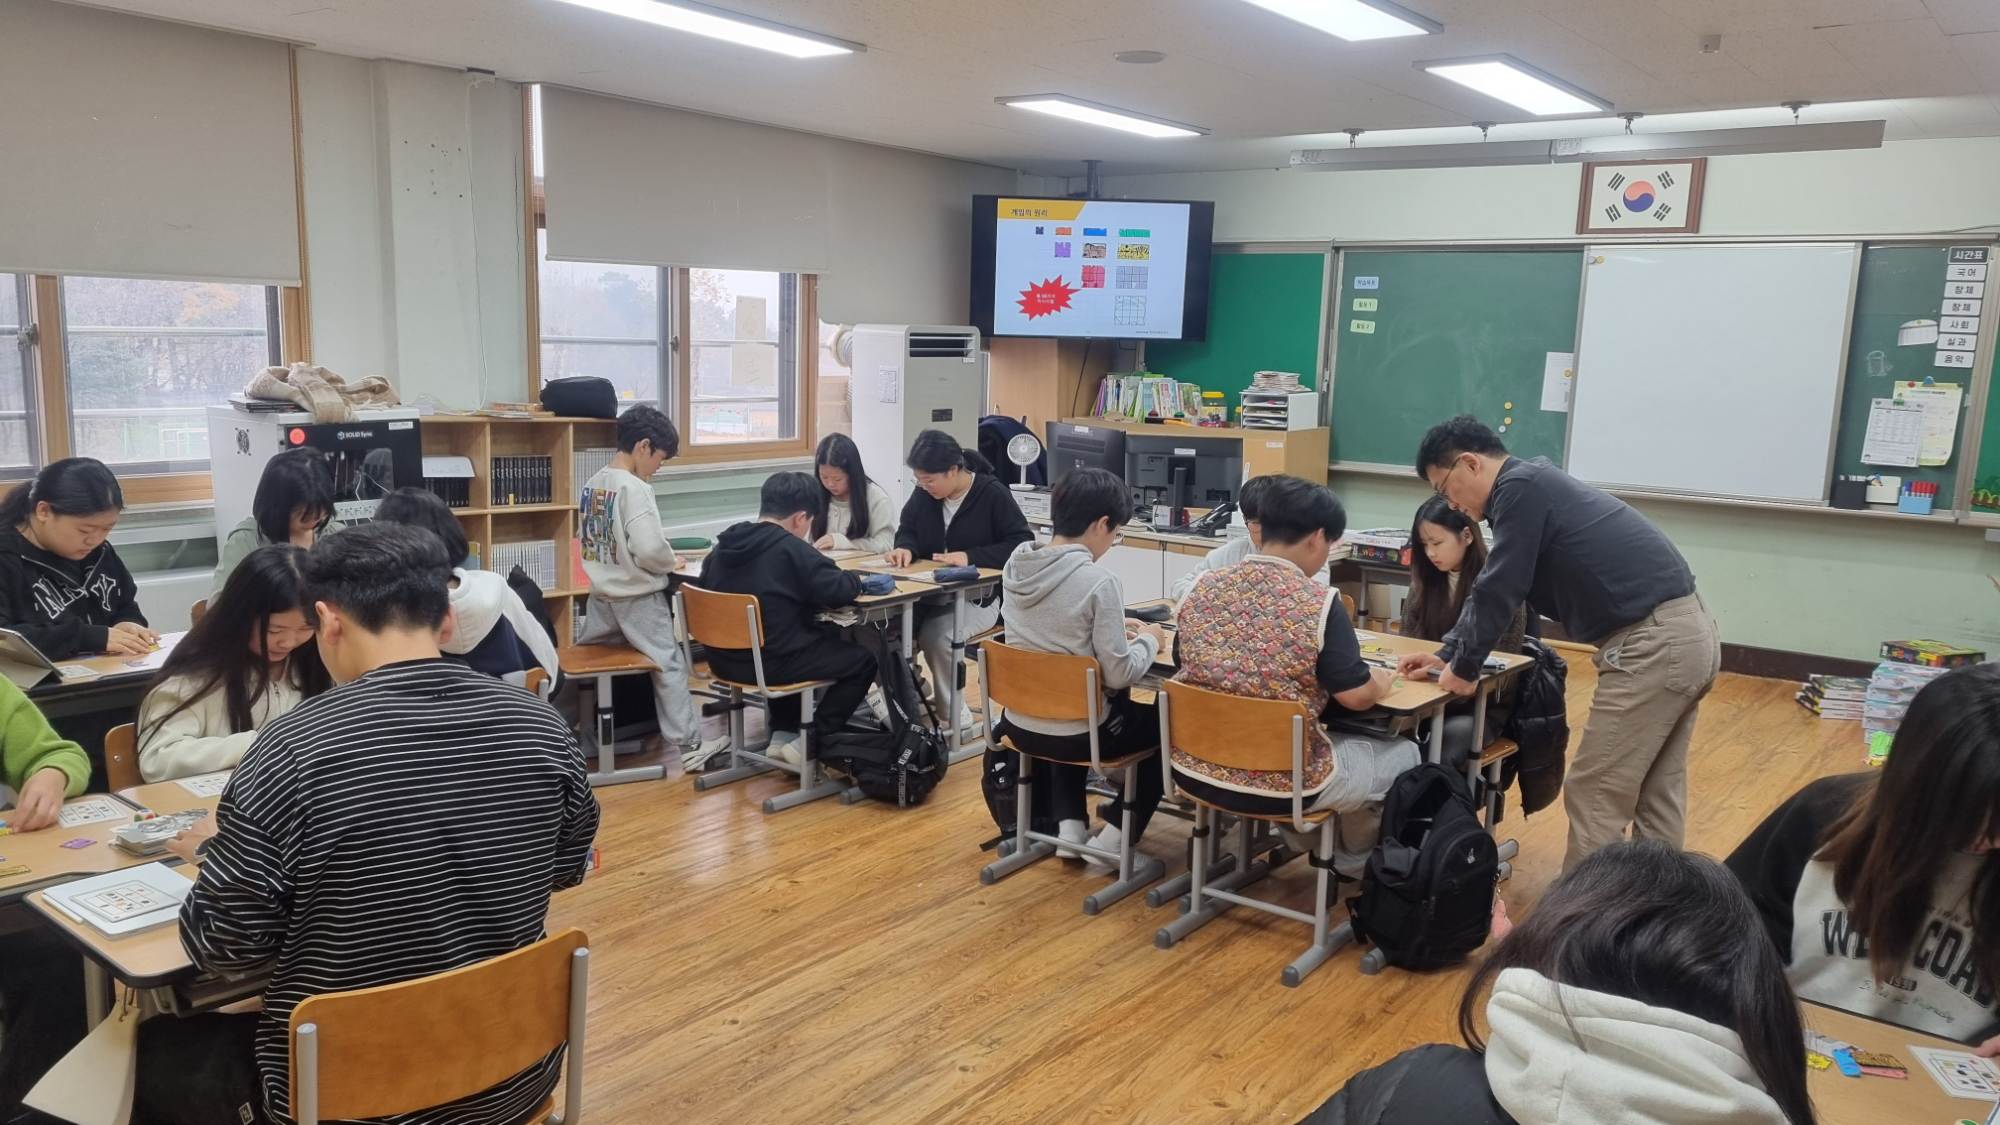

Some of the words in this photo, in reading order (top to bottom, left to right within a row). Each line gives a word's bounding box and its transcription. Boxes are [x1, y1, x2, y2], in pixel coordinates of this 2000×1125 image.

[1011, 208, 1032, 217] 게임의
[1034, 208, 1048, 217] 원리
[1953, 250, 1984, 260] 시간표
[1956, 267, 1977, 277] 국어
[1954, 285, 1974, 295] 창체
[1951, 302, 1971, 312] 창체
[1949, 320, 1969, 330] 사회
[1947, 337, 1967, 347] 실과
[1944, 354, 1964, 364] 음악
[345, 431, 361, 439] SOLID
